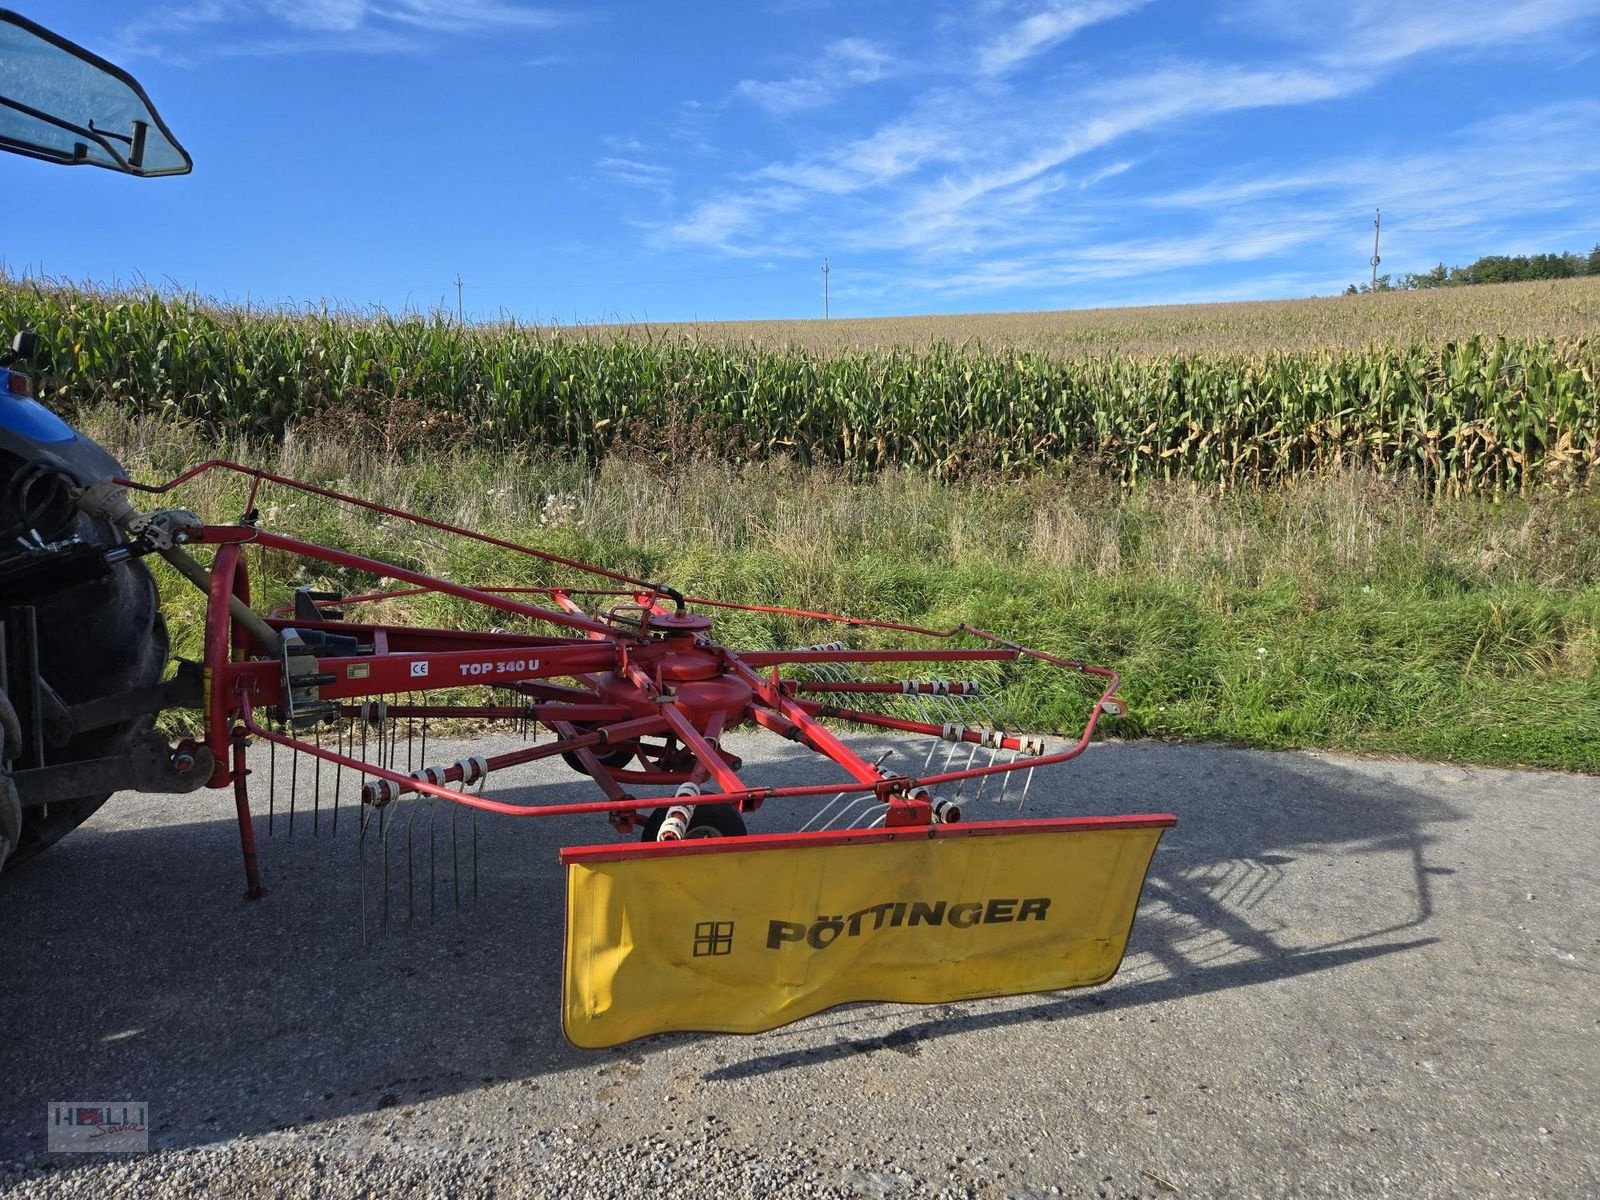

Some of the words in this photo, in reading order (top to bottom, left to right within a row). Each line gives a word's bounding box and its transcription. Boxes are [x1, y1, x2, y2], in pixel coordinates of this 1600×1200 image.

[412, 663, 426, 674] CE
[459, 663, 493, 676] TOP
[496, 661, 526, 673] 340
[528, 659, 540, 671] U
[766, 897, 1051, 950] PÖTTINGER
